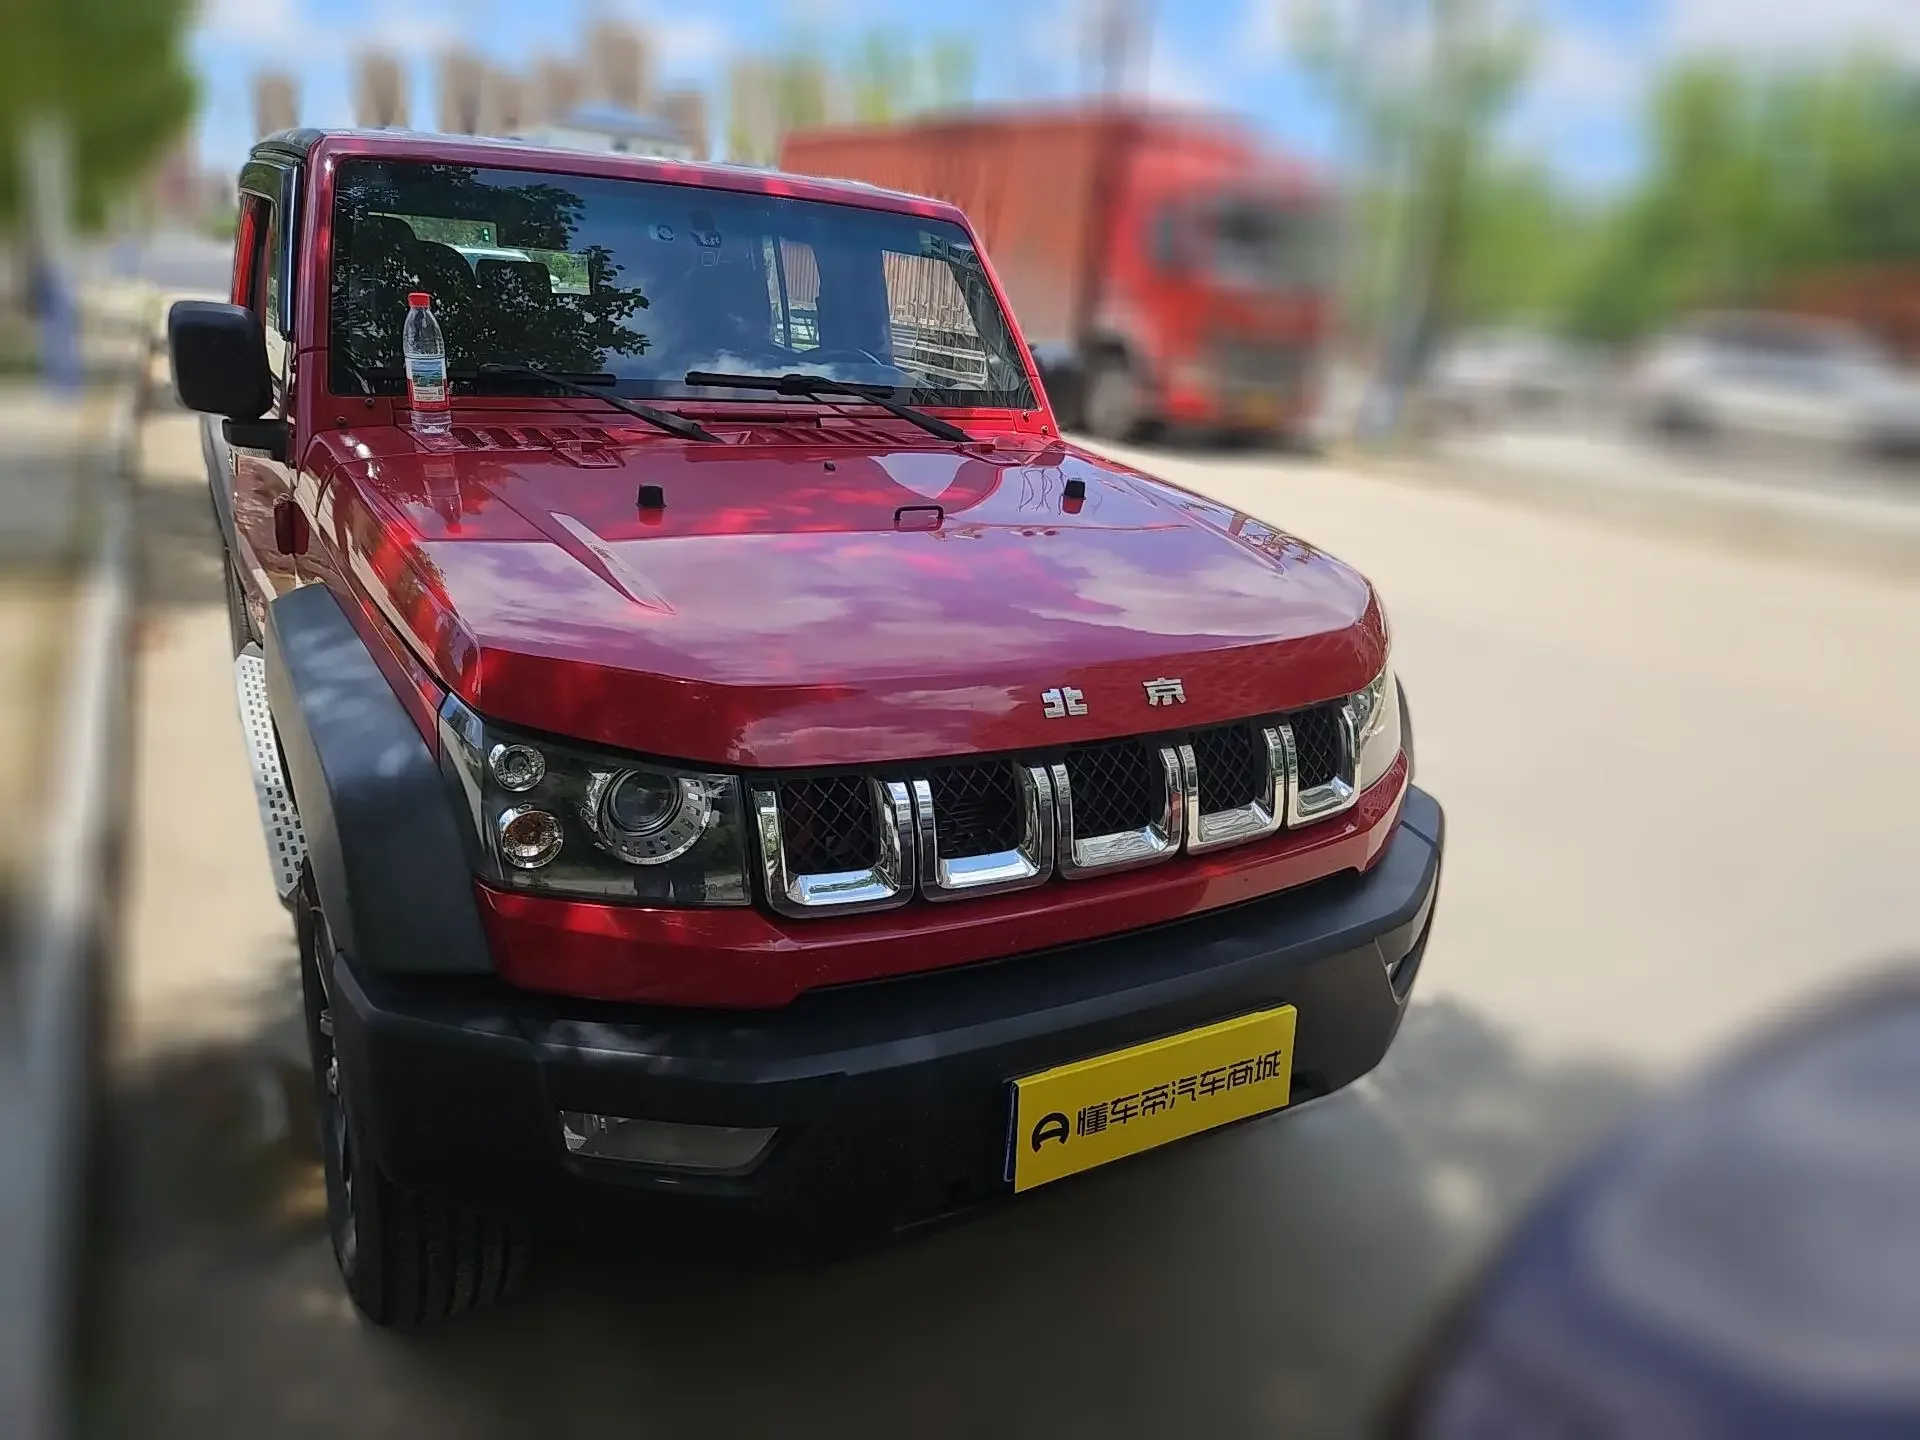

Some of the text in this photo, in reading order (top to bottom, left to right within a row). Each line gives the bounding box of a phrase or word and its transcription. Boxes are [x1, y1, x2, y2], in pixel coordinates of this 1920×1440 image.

[1042, 677, 1187, 718] 北京
[1076, 1049, 1282, 1137] 懂车帝汽车商城
